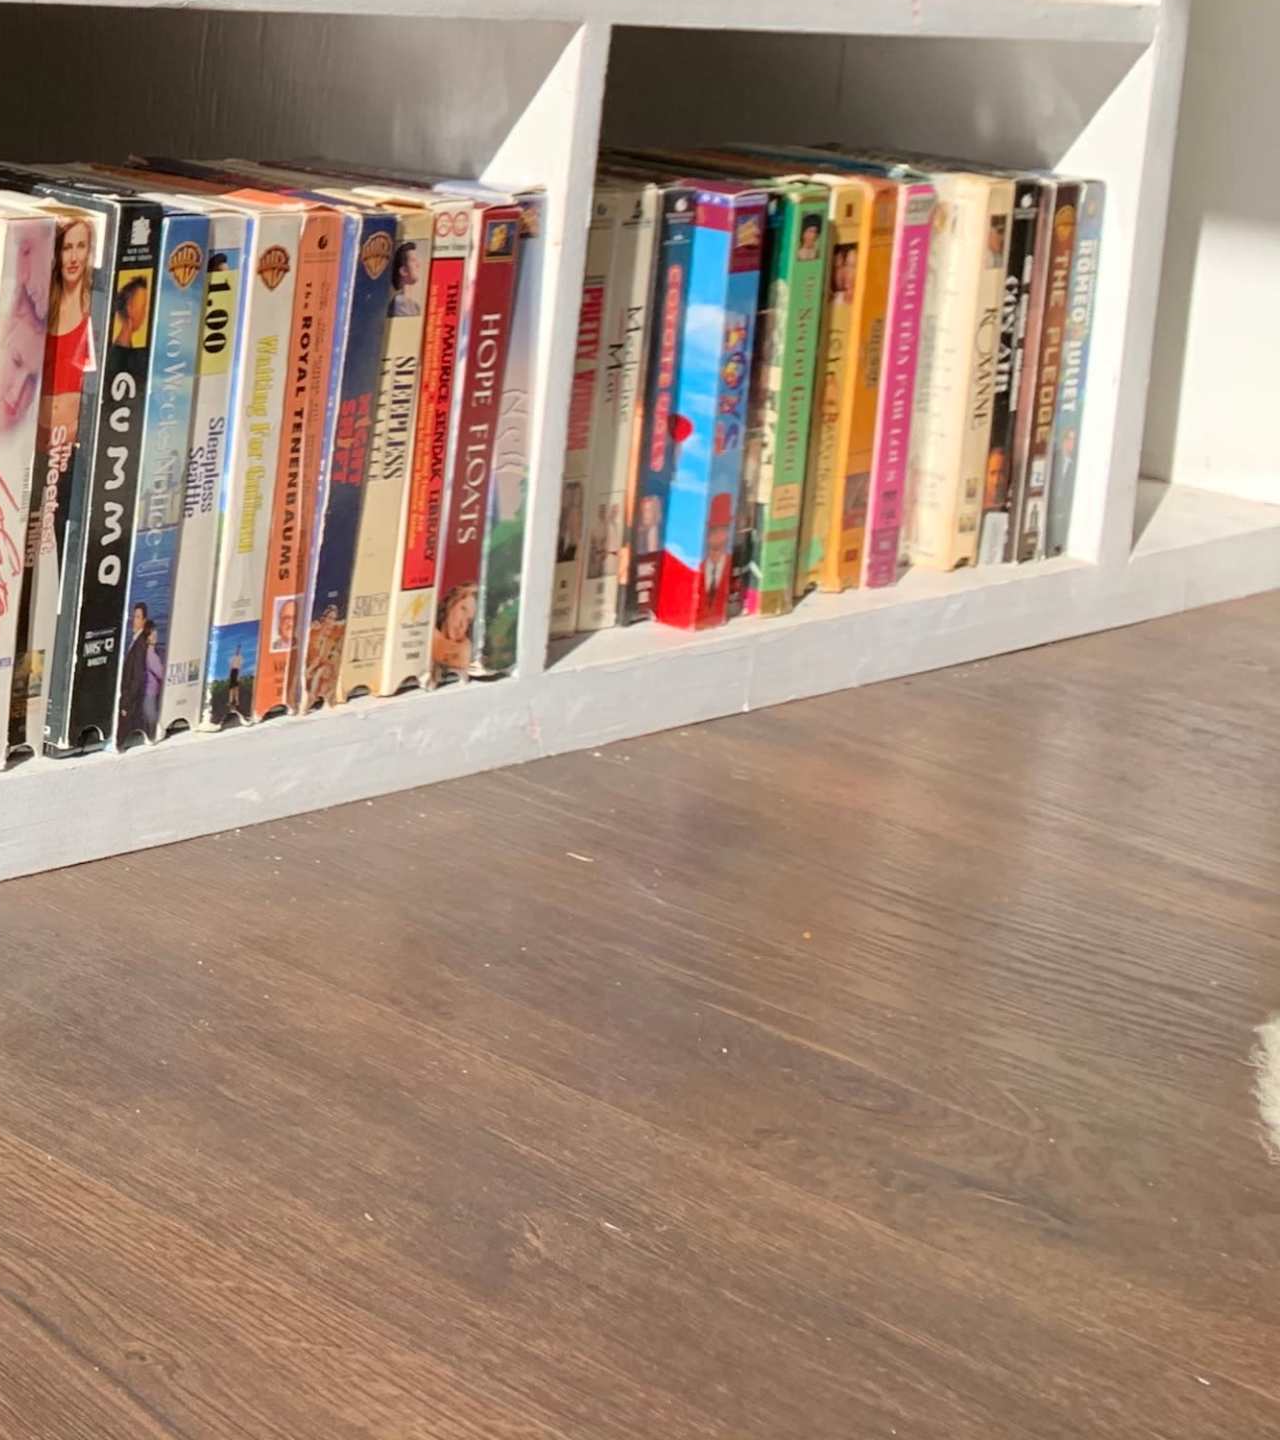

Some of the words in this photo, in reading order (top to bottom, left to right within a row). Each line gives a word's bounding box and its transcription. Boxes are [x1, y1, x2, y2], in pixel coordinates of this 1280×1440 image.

[203, 279, 231, 354] 1.00
[303, 281, 313, 310] The
[446, 282, 460, 322] THE
[1050, 250, 1070, 308] THE
[1070, 238, 1091, 324] ROMEO
[294, 314, 314, 400] ROYAL
[439, 323, 457, 406] MAURICE
[470, 311, 503, 408] HOPE
[574, 286, 604, 360] PRETTY
[792, 308, 813, 379] Secret
[247, 334, 279, 418] Waiting
[1035, 328, 1062, 444] PLEDGE
[1061, 340, 1082, 413] JULIET
[59, 440, 70, 474] The
[247, 420, 271, 459] For
[382, 356, 417, 481] SLEEPLESS
[431, 409, 448, 485] SENDAK
[783, 385, 806, 474] Garden
[40, 425, 68, 556] Sweetest
[97, 372, 137, 587] GUMMO
[183, 446, 204, 520] Seattle
[200, 416, 225, 515] Sleepless
[278, 406, 304, 581] TENENBAUMS
[455, 421, 492, 546] FLOATS
[423, 487, 441, 561] LIBRARY
